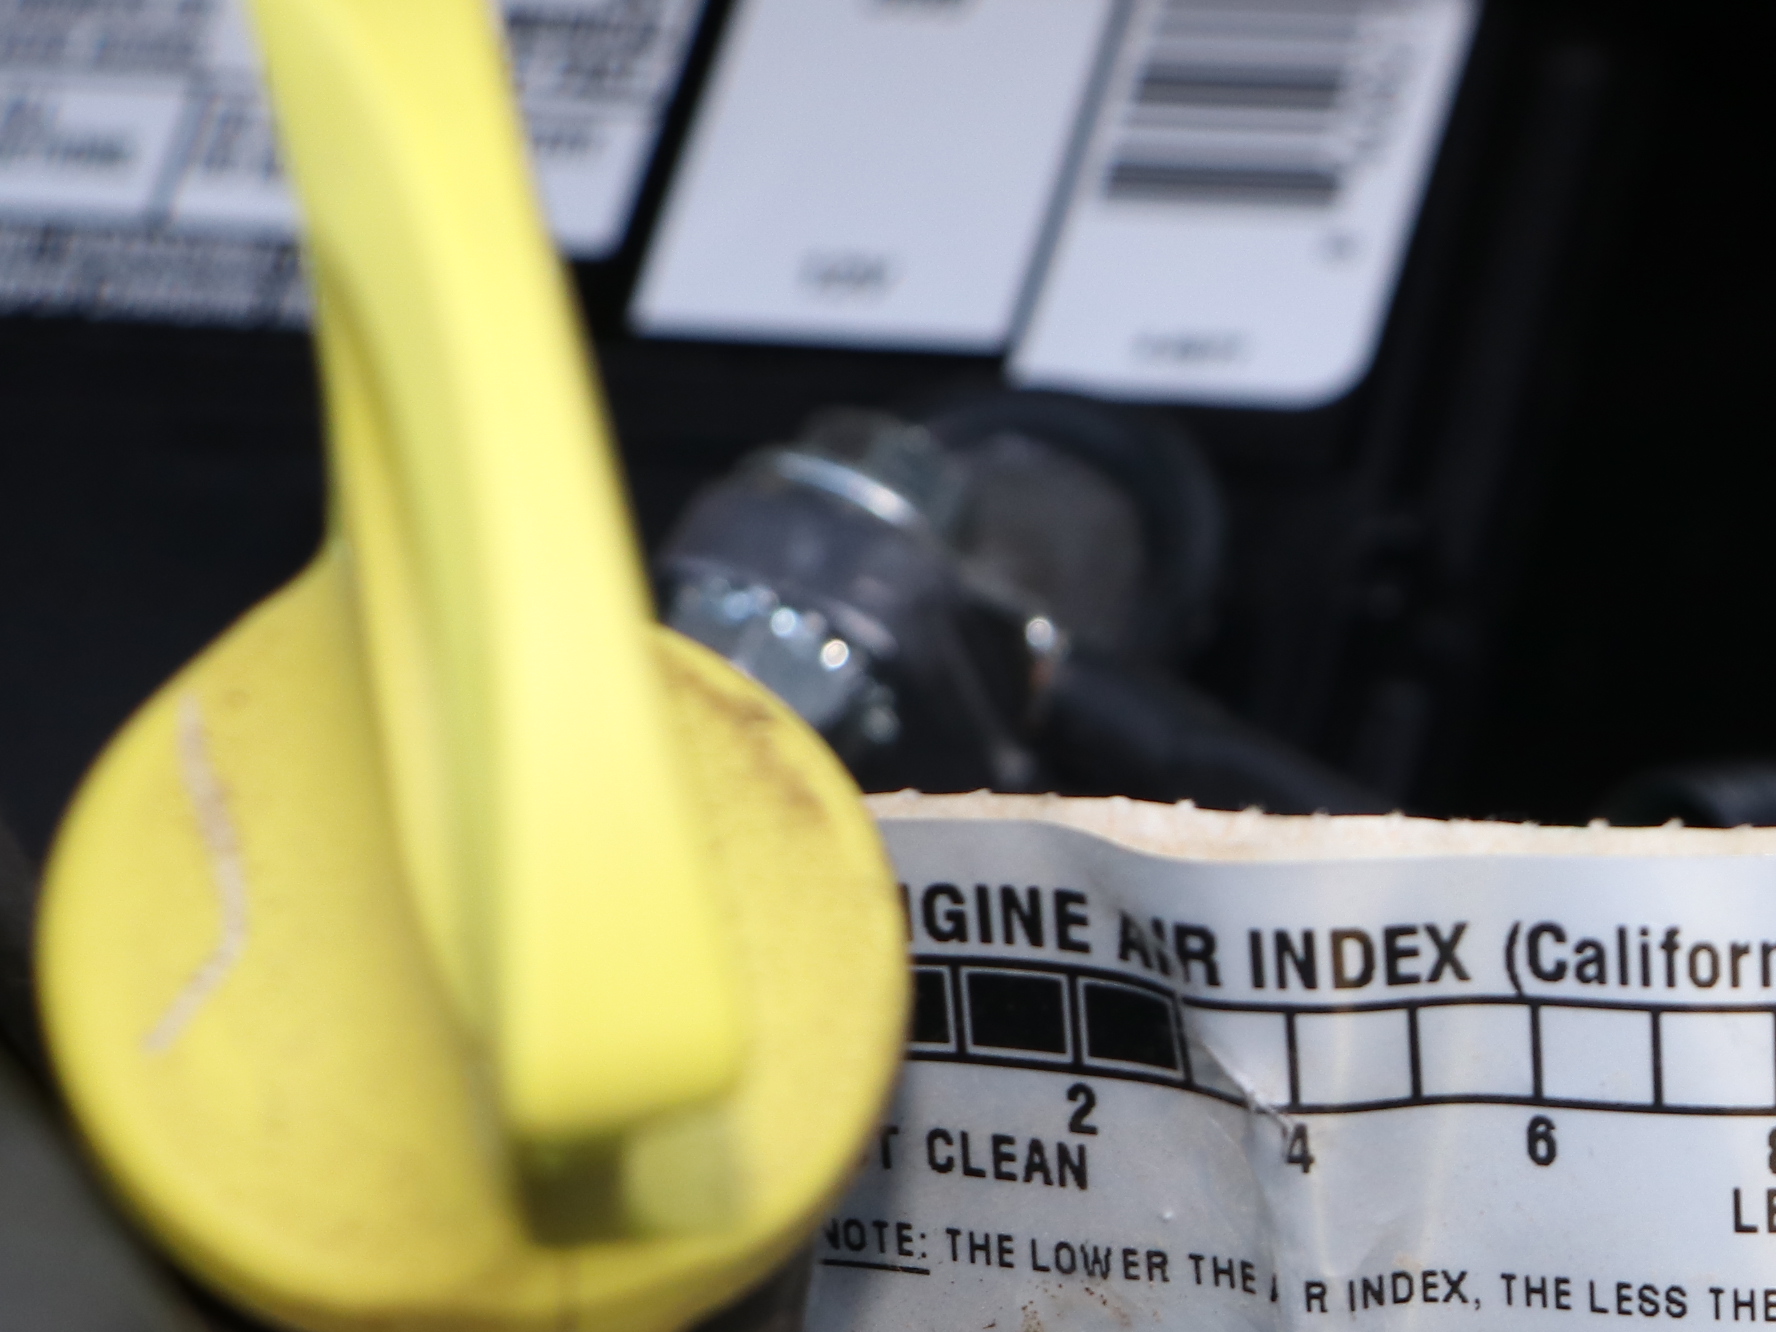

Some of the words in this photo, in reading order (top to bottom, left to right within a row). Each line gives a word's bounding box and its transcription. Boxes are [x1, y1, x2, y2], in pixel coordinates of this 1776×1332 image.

[901, 883, 1090, 954] GINE
[1119, 910, 1221, 986] AIR
[1249, 921, 1470, 990] INDEX
[927, 1127, 1088, 1190] CLEAN
[1066, 1083, 1097, 1136] 2
[1283, 1122, 1315, 1174] 4
[1526, 1115, 1557, 1167] 6
[945, 1227, 1013, 1269] THE
[1030, 1236, 1170, 1283] LOWER
[1189, 1253, 1256, 1294] THE
[1348, 1269, 1482, 1312] INDEX,
[1500, 1273, 1572, 1311] THE
[1589, 1279, 1688, 1319] LESS
